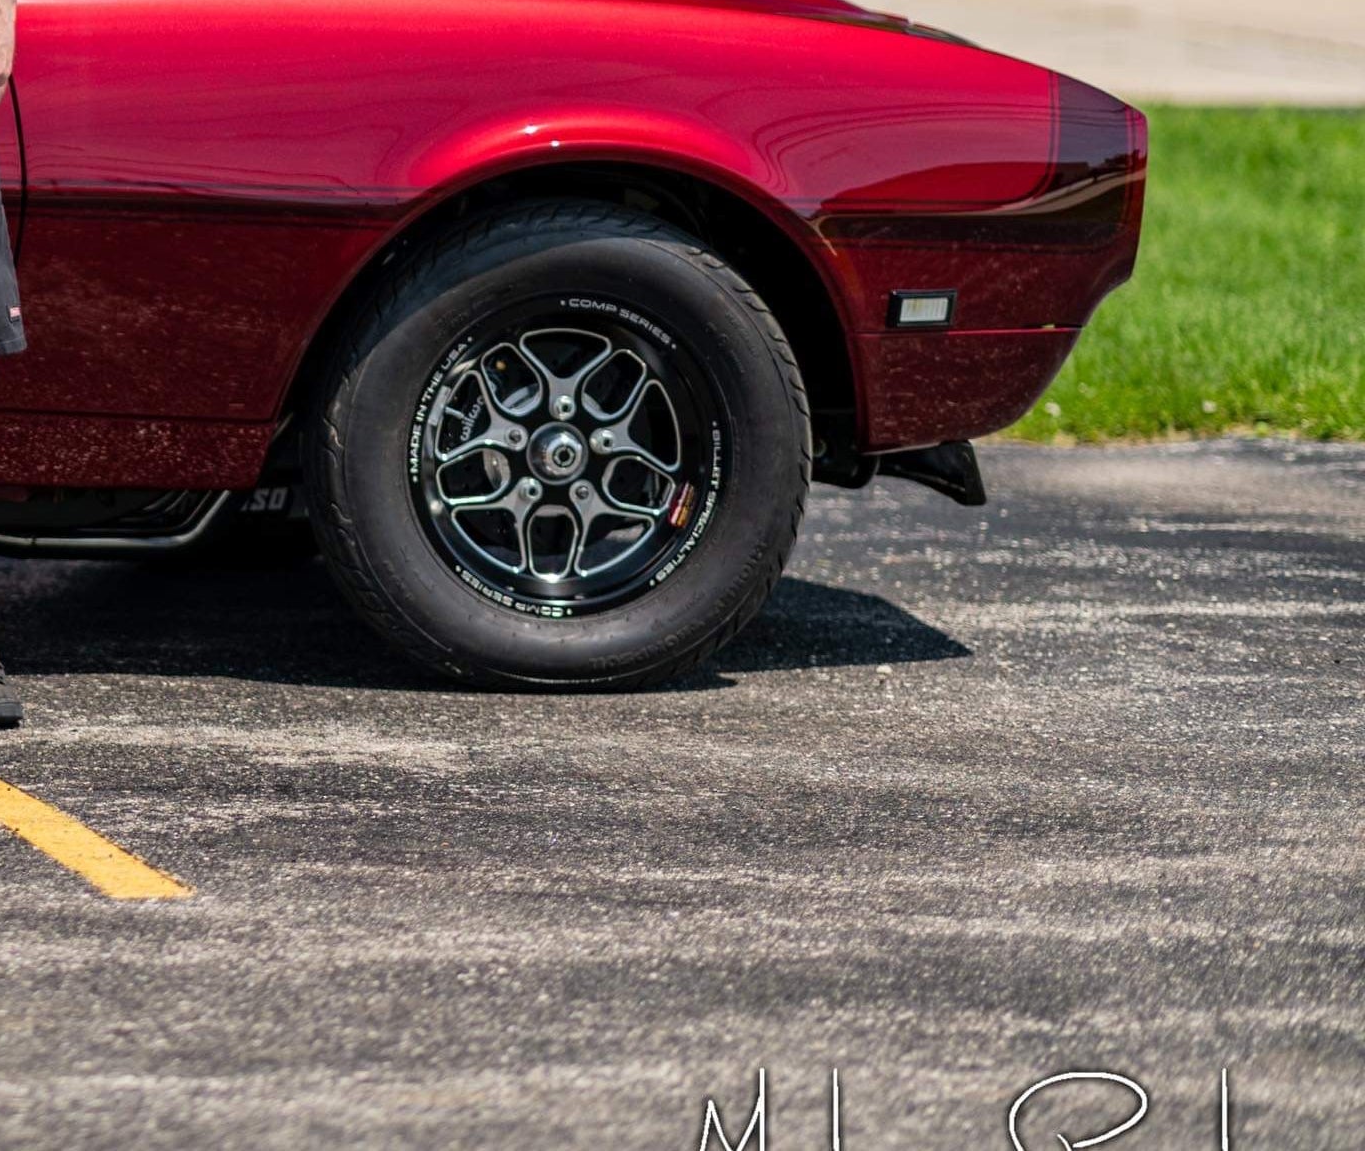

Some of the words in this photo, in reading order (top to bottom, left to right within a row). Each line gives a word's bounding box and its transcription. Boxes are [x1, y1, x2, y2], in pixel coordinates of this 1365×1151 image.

[569, 298, 617, 311] COMP
[618, 308, 672, 345] SERIES
[440, 343, 468, 370] USA
[421, 370, 444, 403] THE
[415, 404, 428, 422] IN
[409, 424, 422, 474] MADE
[710, 429, 721, 489] BILLET
[655, 490, 717, 582] SPECIALTIES
